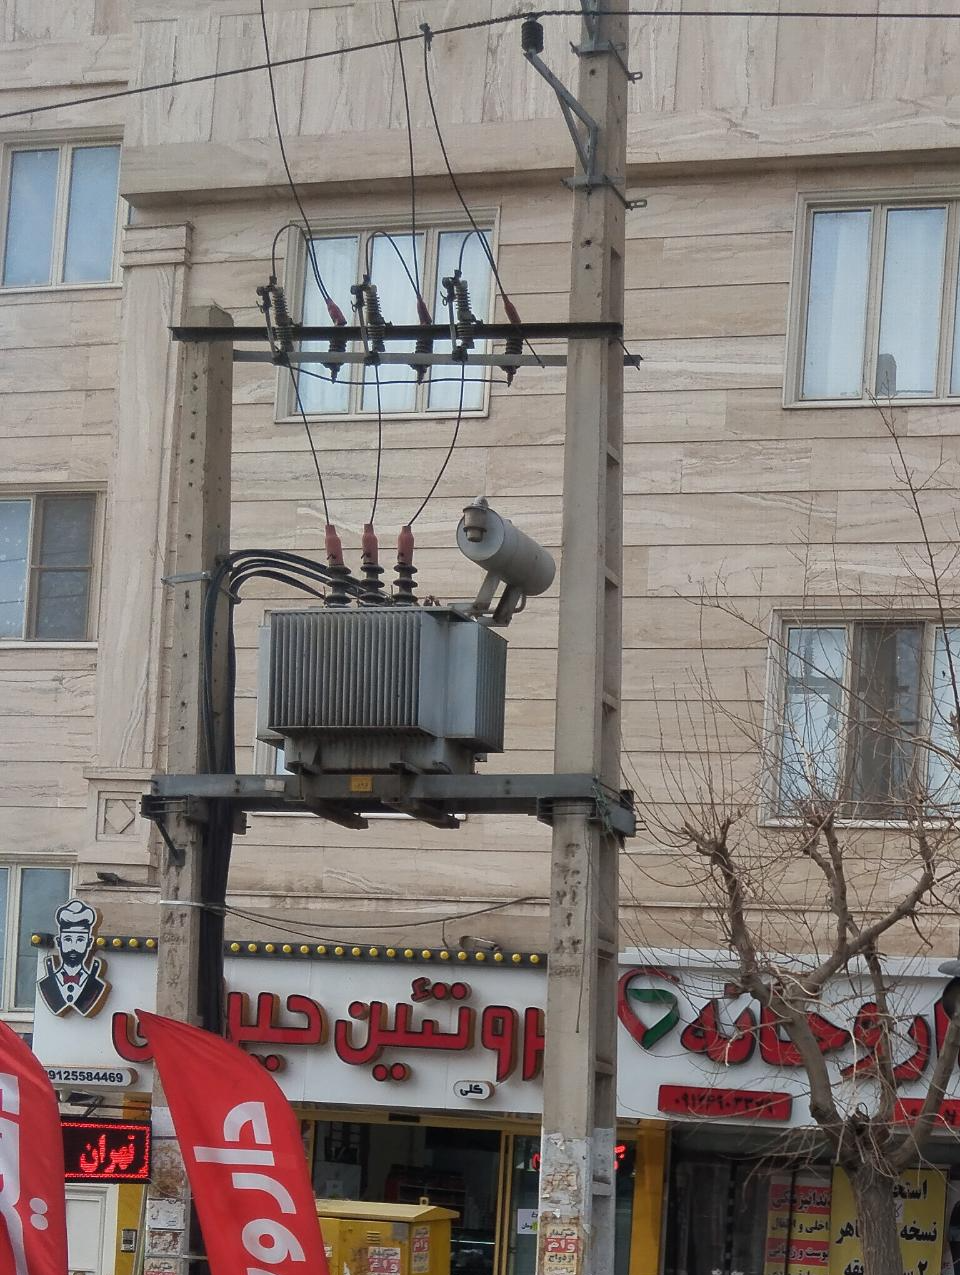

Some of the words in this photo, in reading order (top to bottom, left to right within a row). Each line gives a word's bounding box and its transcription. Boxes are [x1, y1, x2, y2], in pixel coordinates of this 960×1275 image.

[46, 1070, 124, 1083] 9125584469
[459, 1083, 484, 1096] کلی
[80, 1133, 136, 1173] تهران
[804, 1219, 830, 1235] اخلی
[835, 1219, 861, 1244] اهر
[900, 1221, 938, 1242] نسخه
[547, 1239, 576, 1252] وام
[548, 1253, 575, 1264] ازدواج
